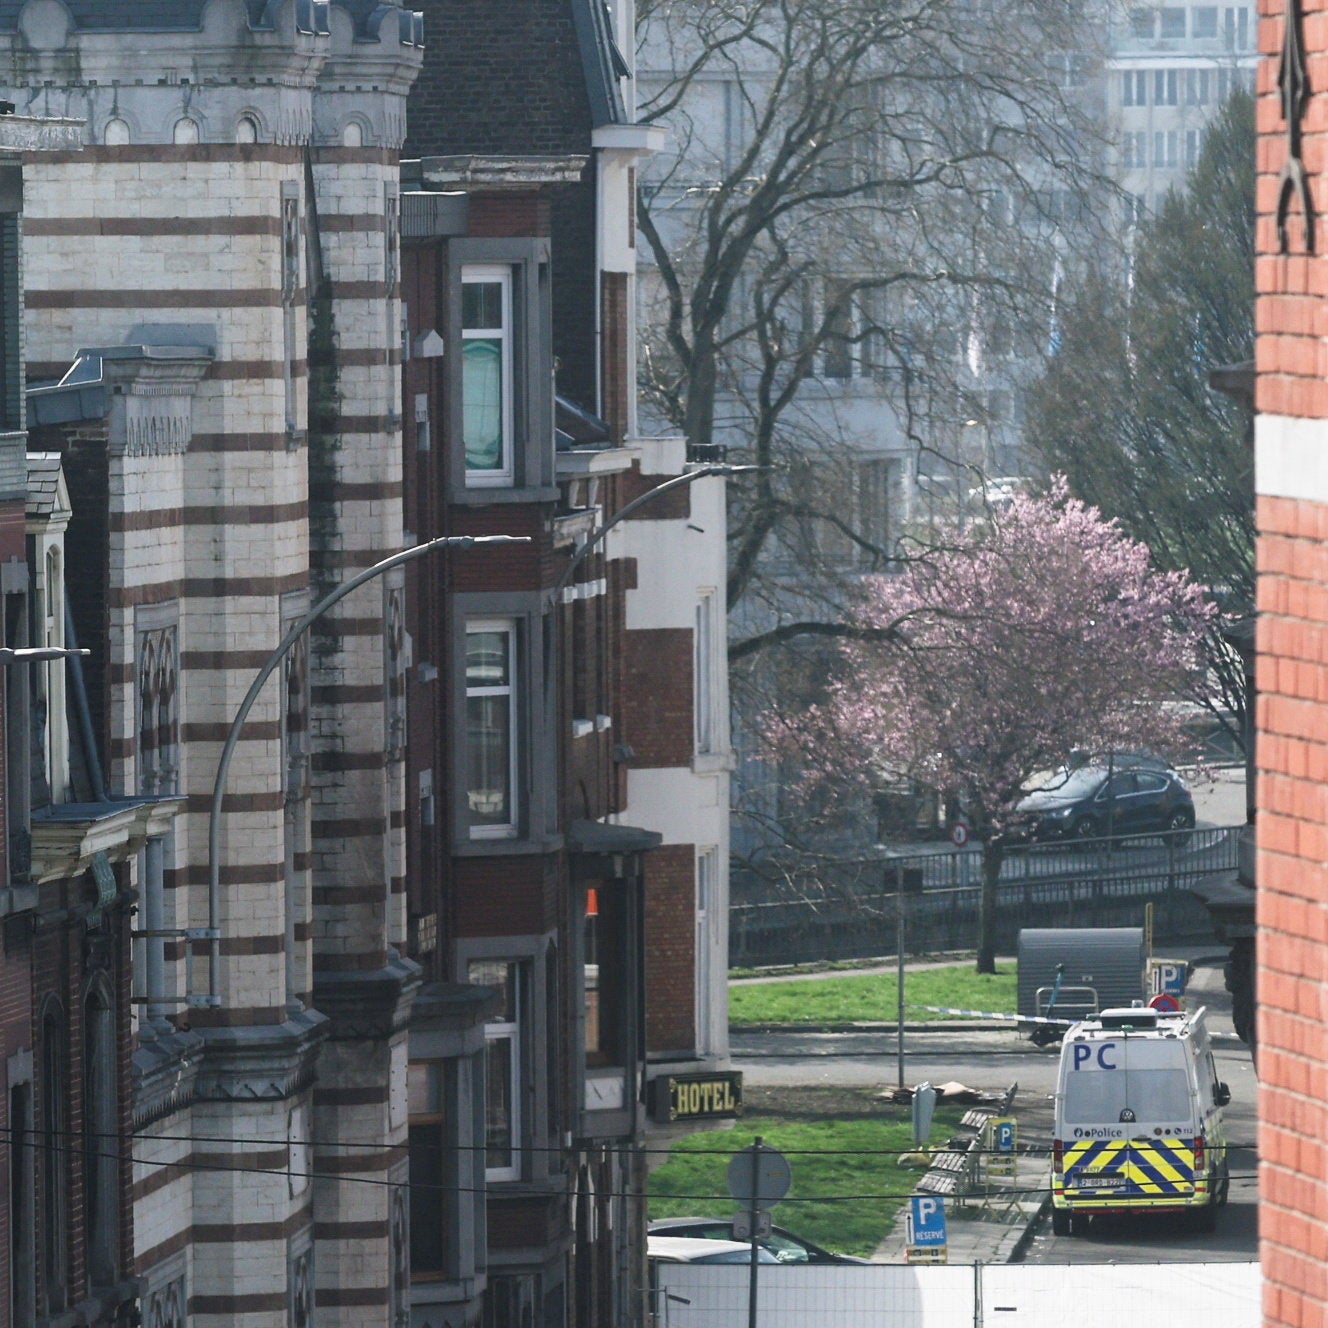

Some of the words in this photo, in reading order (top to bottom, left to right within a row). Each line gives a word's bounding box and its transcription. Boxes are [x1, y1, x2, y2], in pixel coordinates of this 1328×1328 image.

[677, 1081, 735, 1113] HOTEL
[1002, 1127, 1011, 1143] P
[1091, 1127, 1122, 1138] Police
[918, 1198, 937, 1225] P
